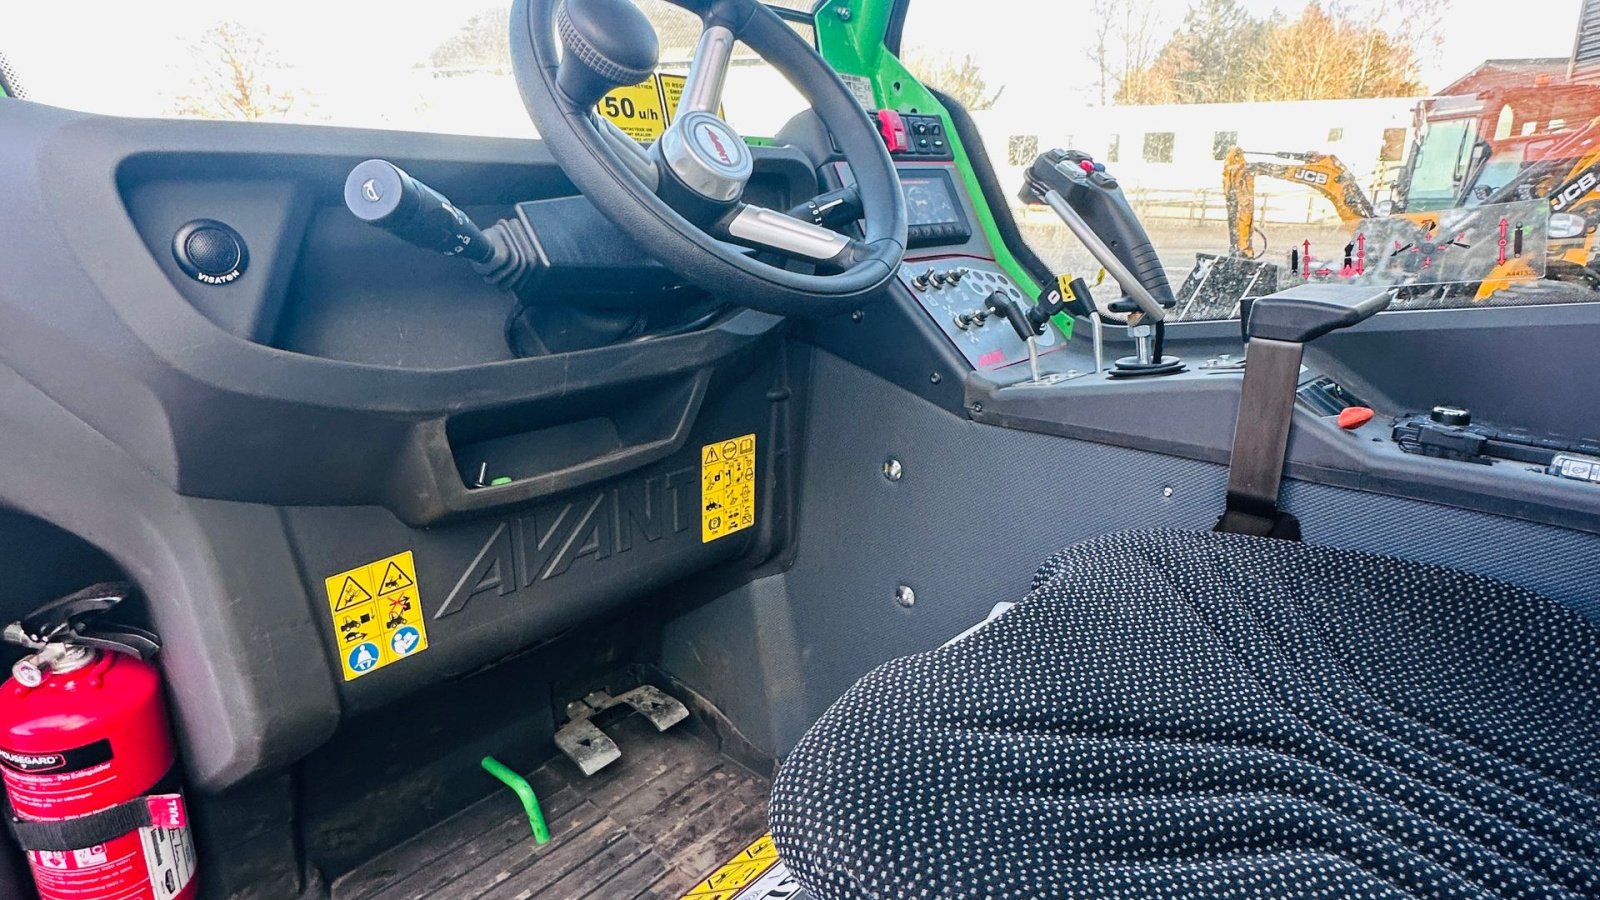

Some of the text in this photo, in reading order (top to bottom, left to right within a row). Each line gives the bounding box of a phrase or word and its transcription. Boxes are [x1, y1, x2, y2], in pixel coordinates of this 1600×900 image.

[605, 96, 658, 120] 50 u/h
[1295, 169, 1328, 185] JCB
[1552, 172, 1597, 211] JCB
[198, 269, 240, 284] VISATON
[434, 465, 697, 620] AVANT
[167, 799, 180, 825] PULL
